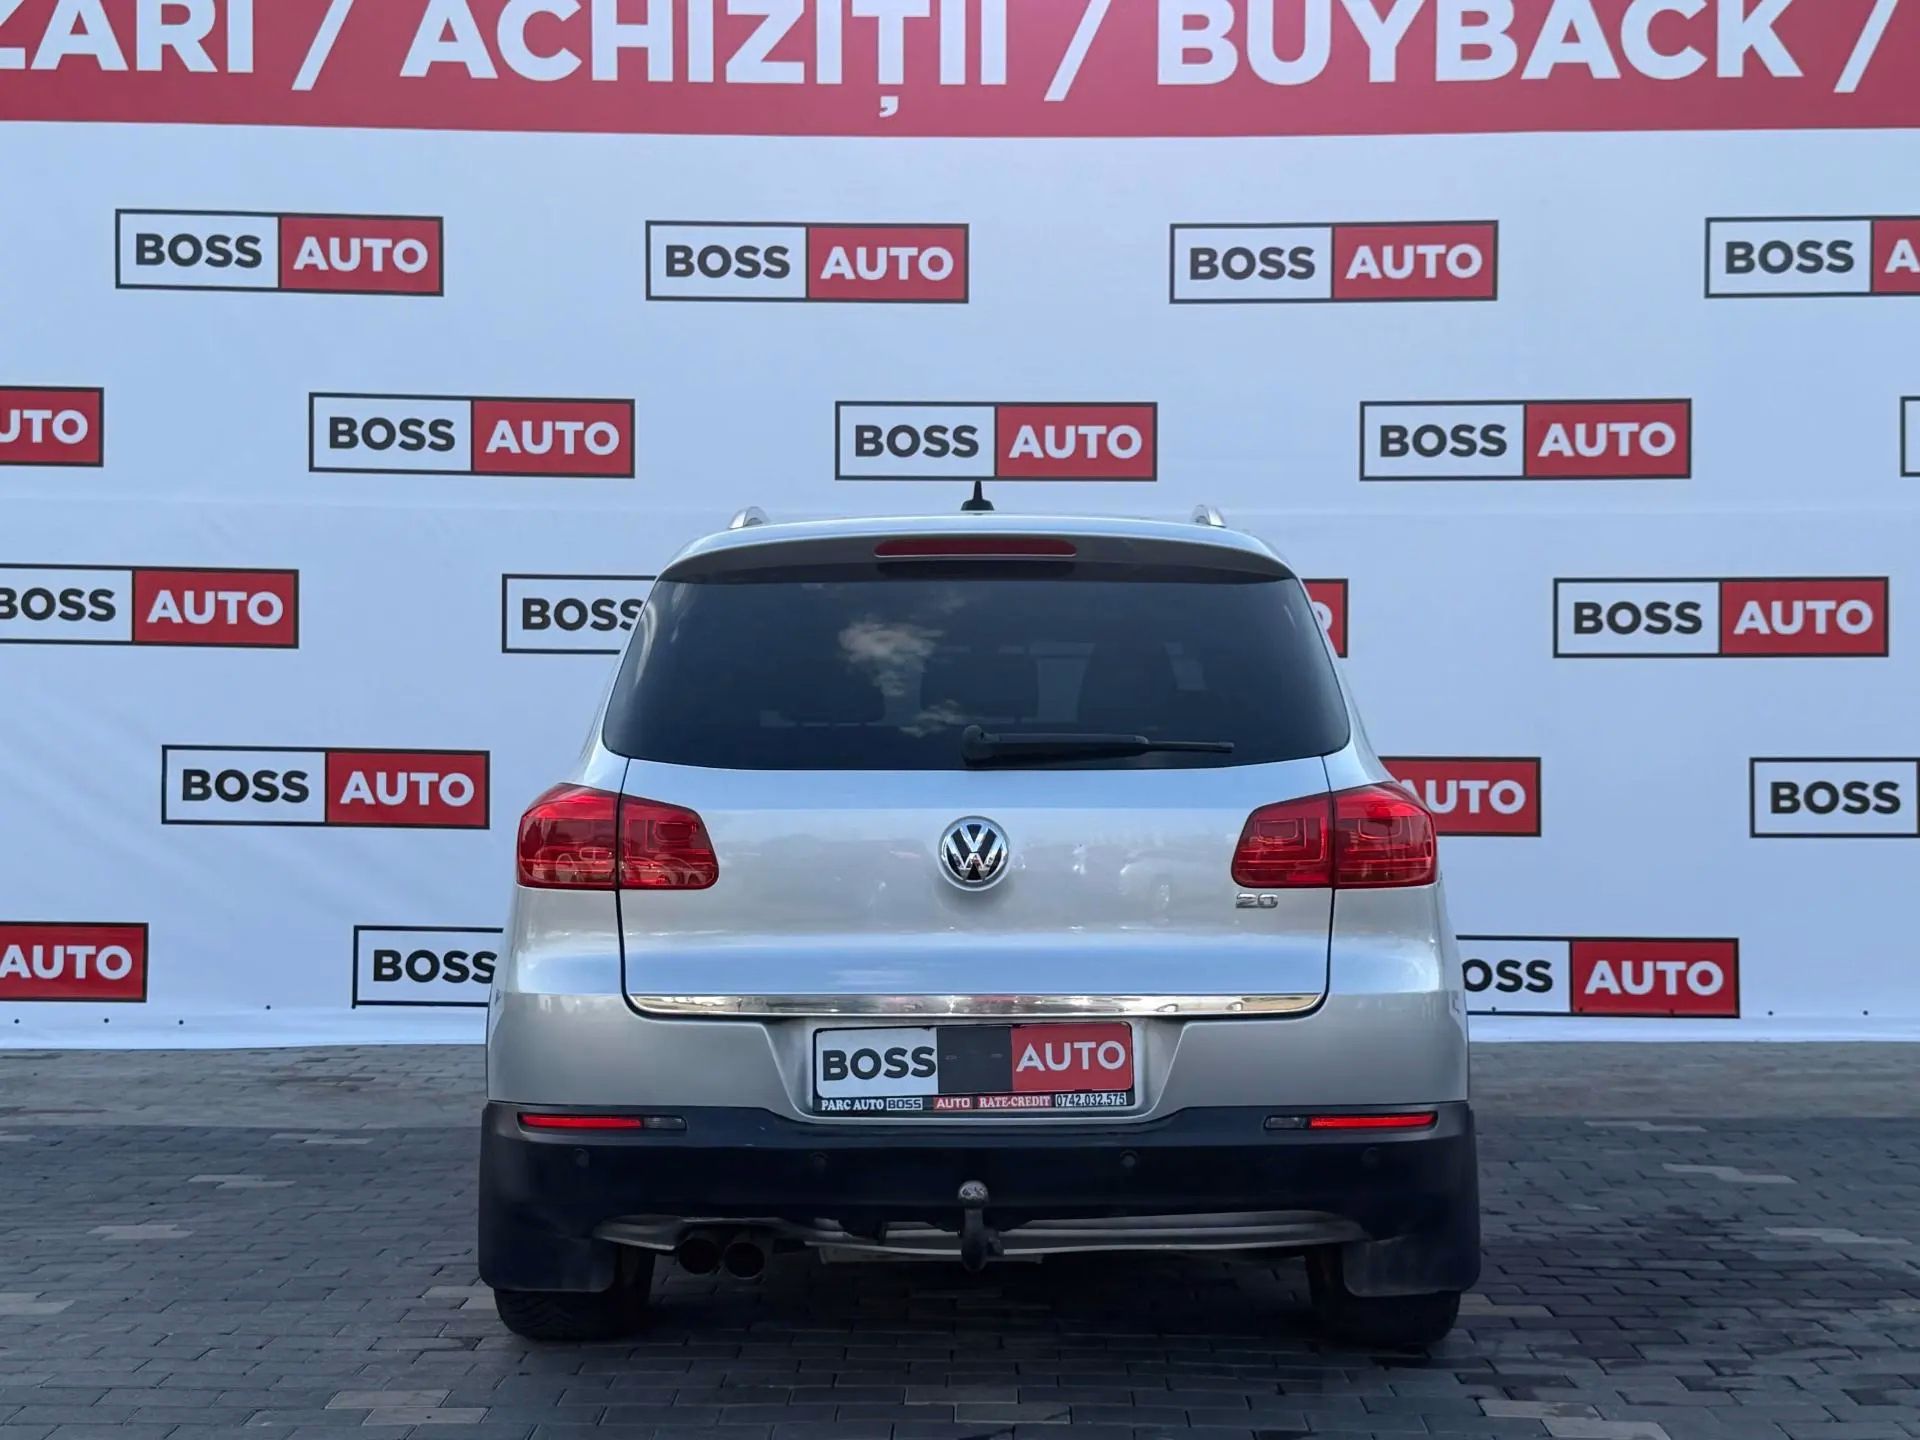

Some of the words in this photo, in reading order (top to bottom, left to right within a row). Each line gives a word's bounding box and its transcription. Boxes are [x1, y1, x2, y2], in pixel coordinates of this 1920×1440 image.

[400, 0, 1007, 117] ACHIZIȚII
[1157, 0, 1803, 85] BUYBACK
[136, 234, 261, 268] BOSS
[294, 237, 428, 273] AUTO
[667, 246, 789, 278] BOSS
[821, 246, 953, 280] AUTO
[1191, 247, 1314, 279] BOSS
[1346, 244, 1482, 279] AUTO
[1727, 241, 1853, 273] BOSS
[0, 410, 88, 443] UTO
[330, 417, 455, 451] BOSS
[486, 420, 619, 455] AUTO
[856, 425, 978, 457] BOSS
[1009, 425, 1142, 458] AUTO
[1381, 424, 1506, 457] BOSS
[1538, 422, 1675, 456] AUTO
[147, 590, 283, 625] AUTO
[1575, 602, 1702, 634] BOSS
[1734, 600, 1872, 634] AUTO
[183, 769, 309, 803] BOSS
[340, 772, 474, 806] AUTO
[1771, 781, 1900, 814] BOSS
[0, 945, 132, 979] AUTO
[374, 950, 495, 984] BOSS
[1462, 959, 1553, 993] OSS
[1586, 961, 1723, 995] AUTO
[823, 1046, 936, 1081] BOSS
[1016, 1040, 1126, 1072] AUTO
[822, 1099, 851, 1110] PARC
[853, 1099, 884, 1110] AUTO
[887, 1098, 922, 1110] BOSS
[936, 1098, 970, 1109] AUTO
